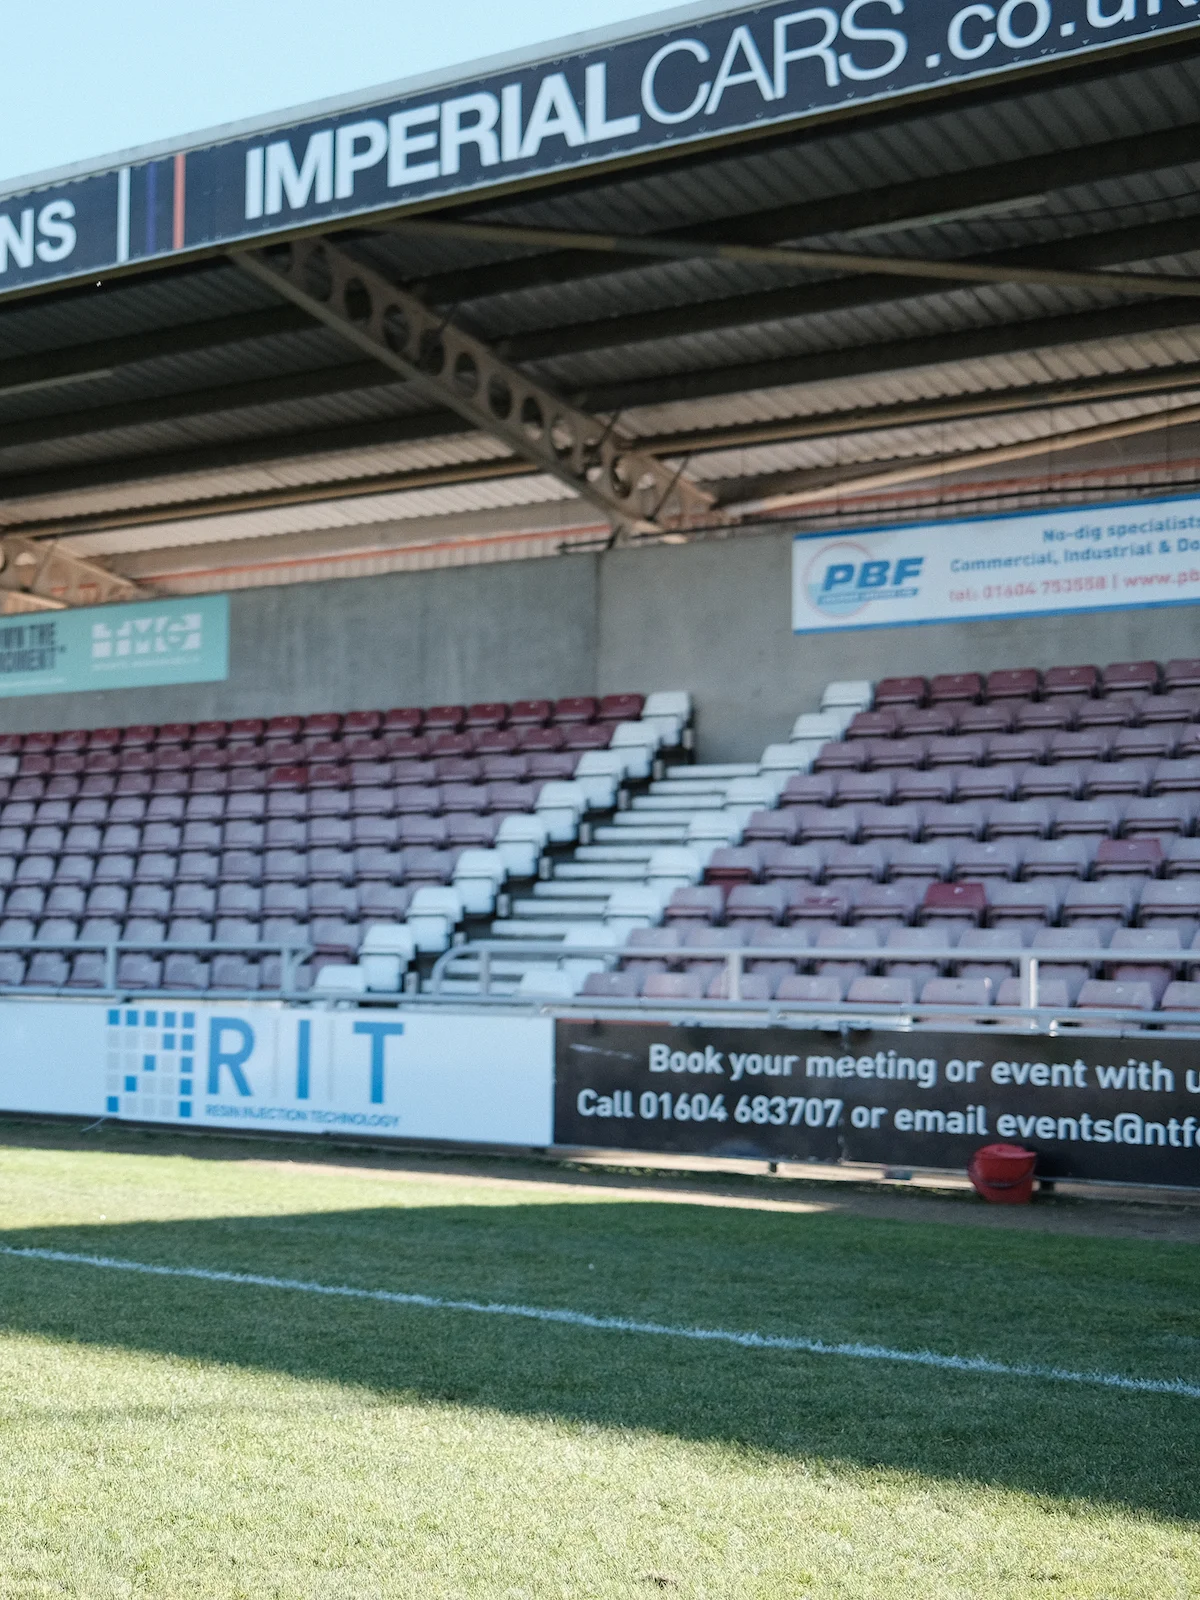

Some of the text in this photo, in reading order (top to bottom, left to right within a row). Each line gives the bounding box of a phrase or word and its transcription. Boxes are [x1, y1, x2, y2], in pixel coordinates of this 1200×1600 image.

[1042, 525, 1102, 543] No-dig
[822, 556, 924, 592] PBF
[950, 549, 1058, 573] Commercial,
[1064, 541, 1153, 563] Industrial
[649, 1043, 724, 1074] Book
[729, 1052, 799, 1081] your
[805, 1049, 937, 1089] meeting
[945, 1058, 984, 1083] or
[990, 1058, 1088, 1088] event
[1095, 1058, 1175, 1093] with
[576, 1088, 635, 1118] Call
[639, 1090, 728, 1122] 01604
[734, 1094, 843, 1128] 683707
[850, 1105, 888, 1129] or
[893, 1104, 988, 1136] email
